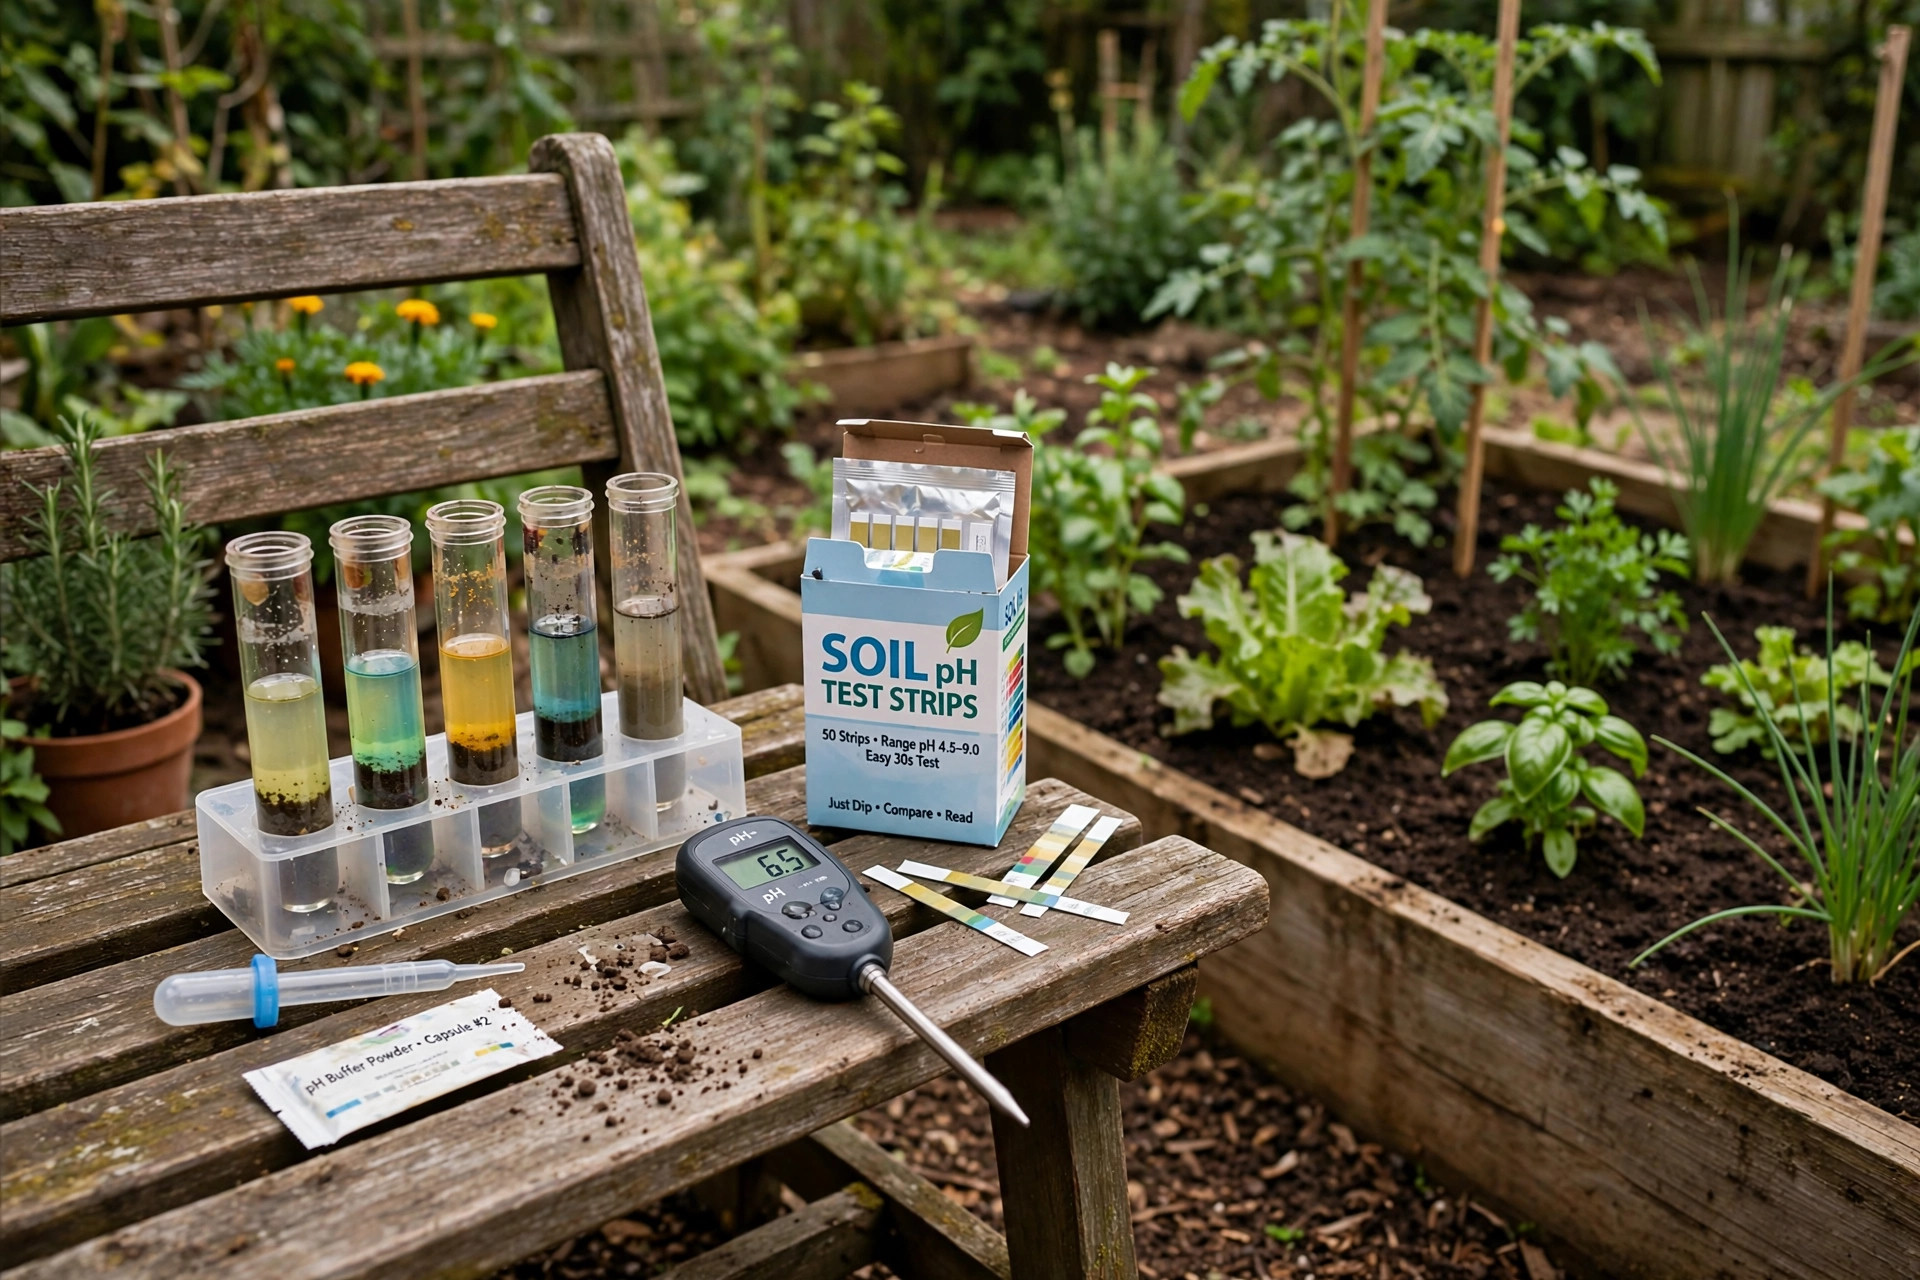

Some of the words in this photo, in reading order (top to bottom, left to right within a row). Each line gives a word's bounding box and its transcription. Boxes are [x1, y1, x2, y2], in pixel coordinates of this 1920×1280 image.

[821, 632, 928, 682] SOIL
[935, 657, 978, 690] pH
[820, 678, 884, 710] TEST
[889, 686, 979, 720] STRIPS
[821, 728, 837, 742] 50
[838, 730, 871, 748] Strips
[880, 734, 917, 752] Range
[919, 739, 936, 754] pH
[865, 749, 892, 767] Easy
[893, 753, 914, 767] 30s
[915, 754, 940, 769] Test
[828, 796, 851, 811] Just
[852, 799, 873, 815] Dip
[883, 802, 934, 820] Compare
[945, 809, 974, 824] Read
[757, 848, 805, 878] 6.5
[762, 886, 787, 905] pH
[304, 1077, 327, 1097] pH
[324, 1063, 366, 1084] Buffer
[365, 1043, 414, 1067] Powder
[423, 1023, 474, 1045] Capsule
[472, 1016, 492, 1028] #2
